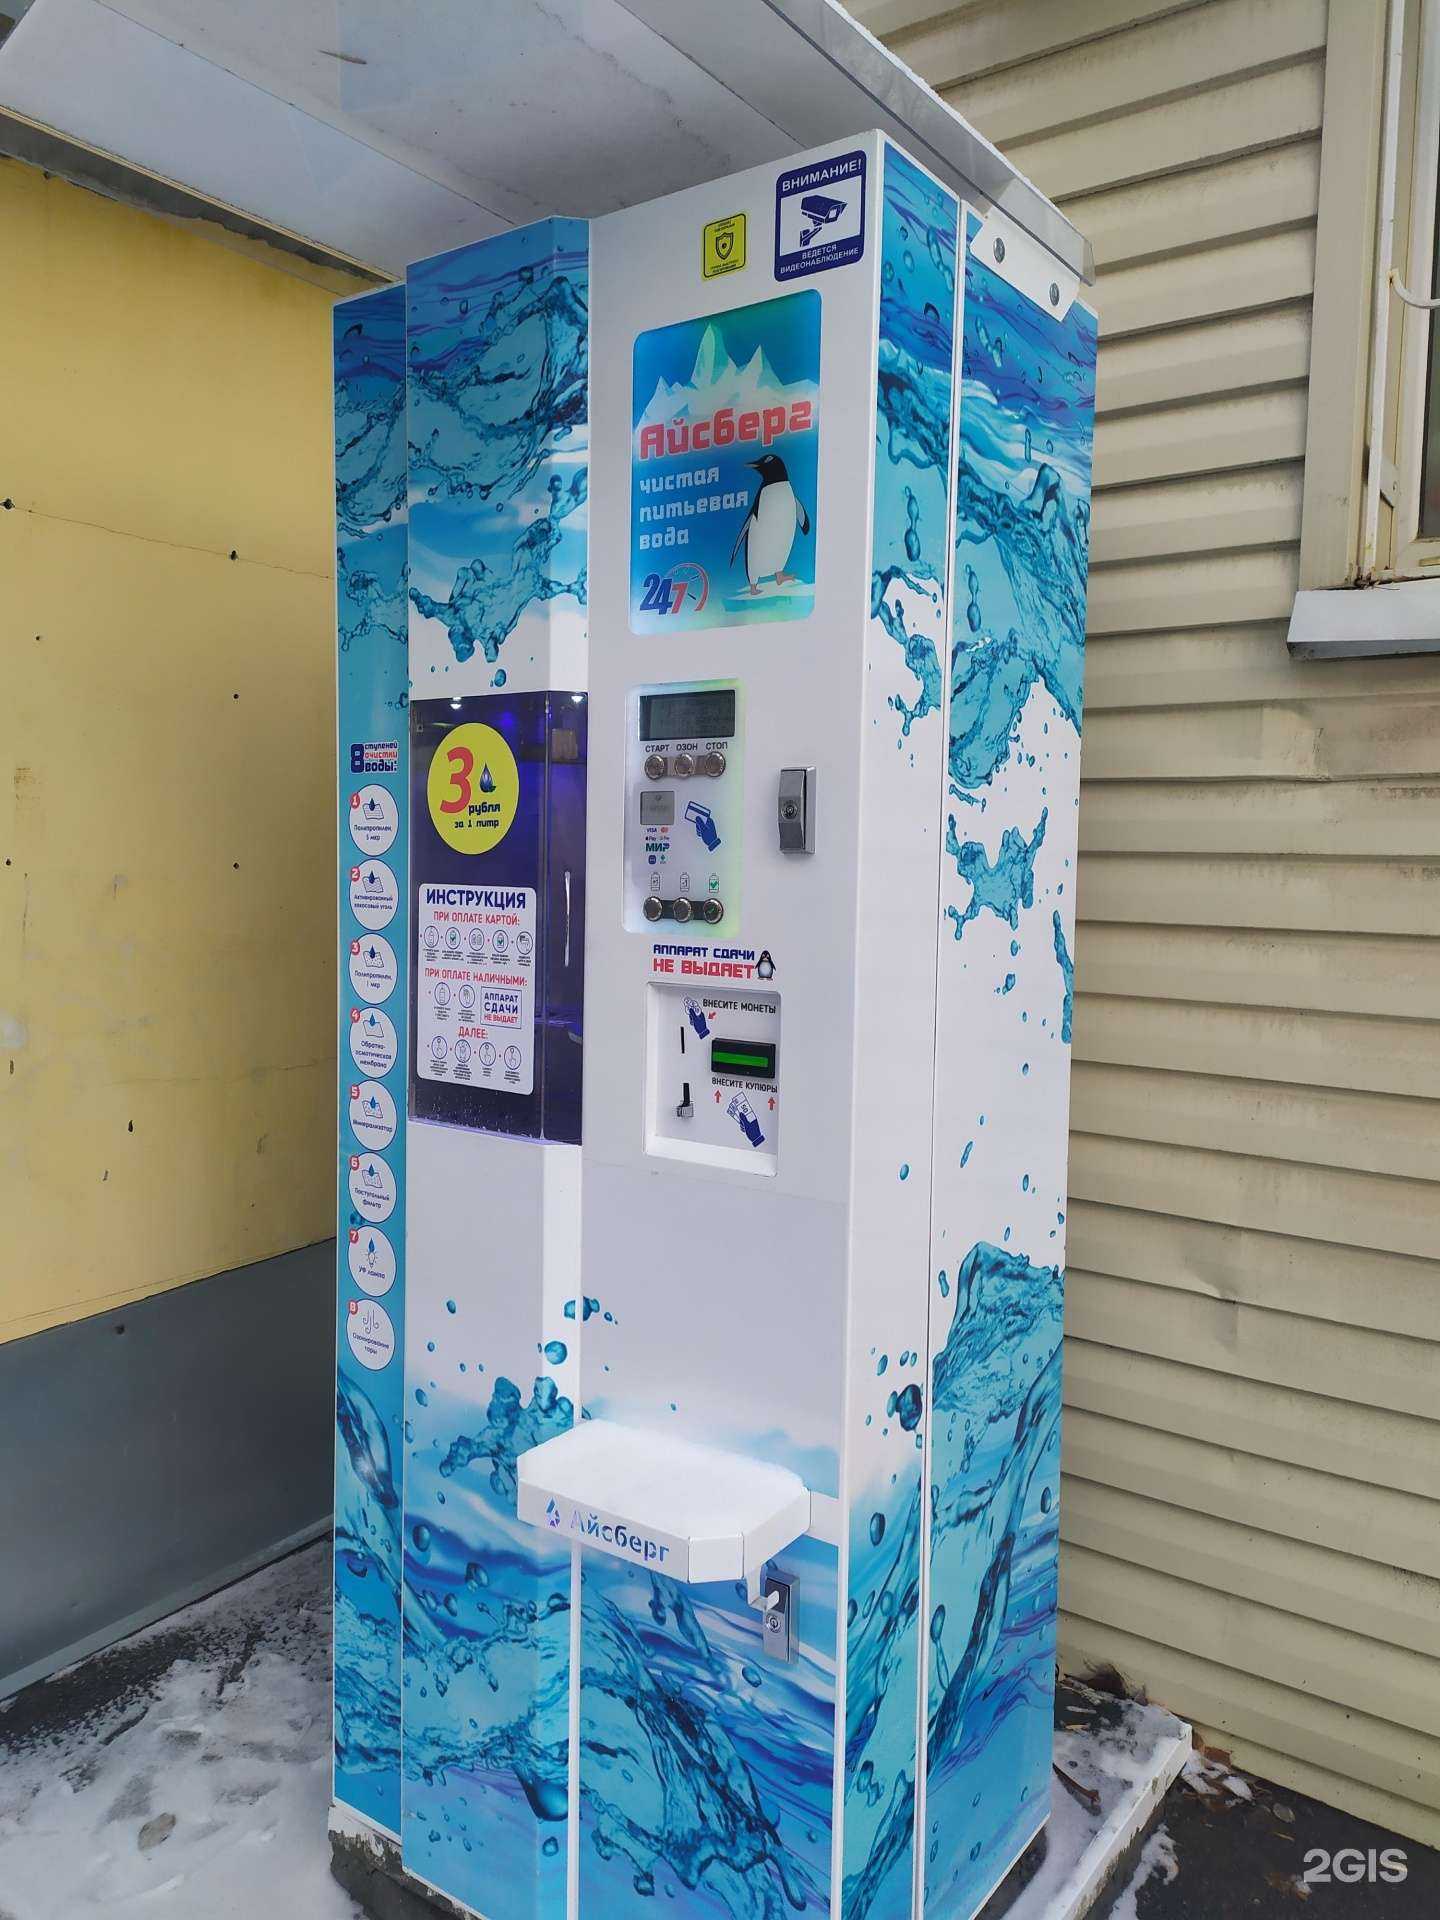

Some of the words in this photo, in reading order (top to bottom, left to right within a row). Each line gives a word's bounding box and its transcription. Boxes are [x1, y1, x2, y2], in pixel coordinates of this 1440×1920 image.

[782, 158, 862, 192] ВНИМАНИЕ!
[780, 246, 859, 274] ВИДЕОНАБЛЮДЕНИЕ
[802, 244, 837, 260] ВЕДЕТСЯ
[639, 399, 813, 461] Айсберг
[639, 466, 720, 494] чистая
[639, 490, 749, 523] питьевая
[639, 525, 689, 550] вода
[645, 744, 670, 753] СТАРТ
[676, 743, 698, 752] ОЗОН
[706, 741, 728, 751] СТОП
[351, 743, 364, 773] 8
[364, 759, 398, 772] воды:
[439, 746, 474, 814] 3
[468, 802, 501, 816] рубля
[454, 821, 464, 829] за
[467, 820, 473, 828] 1
[476, 819, 500, 828] литр
[646, 843, 670, 852] МИР
[426, 888, 526, 910] ИНСТРУКЦИЯ
[433, 910, 449, 922] ПРИ
[452, 912, 483, 924] ОПЛАТЕ
[485, 913, 520, 926] КАРТОЙ:
[653, 943, 709, 957] АППАРАТ
[713, 948, 755, 961] СДАЧИ
[424, 967, 440, 979] ПРИ
[441, 969, 471, 981] ОПЛАТЕ
[473, 973, 528, 986] НАЛИЧНЫМИ:
[653, 958, 674, 973] НЕ
[681, 959, 755, 979] ВЫДАЕТ
[484, 992, 519, 1003] АППАРАТ
[702, 998, 739, 1011] ВНЕСИТЕ
[740, 1002, 776, 1014] МОНЕТЫ
[484, 1002, 519, 1014] СДАЧИ
[484, 1013, 493, 1021] НЕ
[492, 1014, 519, 1024] ВЫДАЕТ
[458, 1026, 488, 1039] ДАЛЕЕ:
[711, 1077, 743, 1089] ВНЕСИТЕ
[745, 1082, 778, 1093] КУПЮРЫ
[570, 1509, 670, 1563] Айсберг
